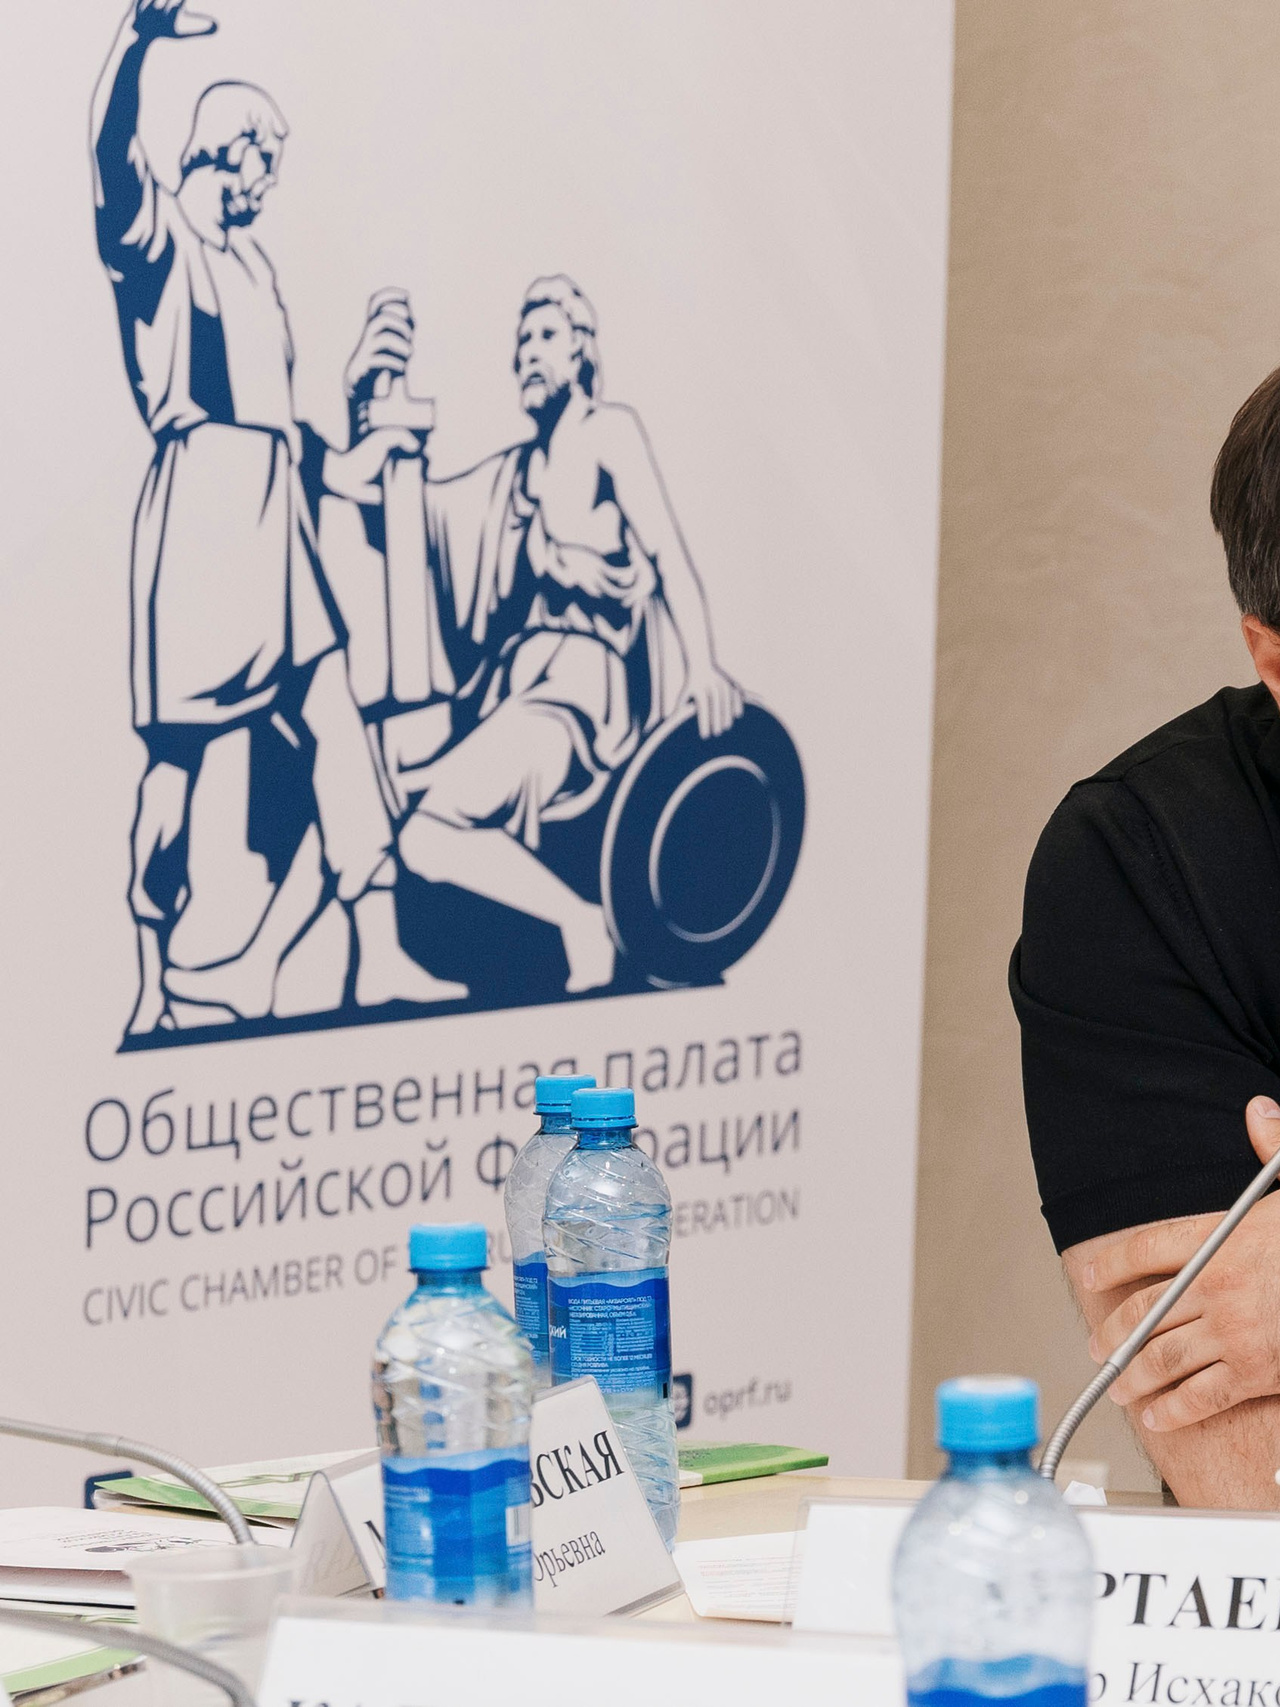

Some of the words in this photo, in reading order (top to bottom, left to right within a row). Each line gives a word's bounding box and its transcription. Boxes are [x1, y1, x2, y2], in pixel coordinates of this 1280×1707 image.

[605, 1029, 802, 1093] палата
[86, 1136, 453, 1249] Российской
[83, 1278, 170, 1326] CIVIC
[180, 1252, 344, 1312] CHAMBER
[353, 1245, 398, 1286] OF
[674, 1186, 800, 1239] ERATION
[530, 1430, 625, 1508] СКАЯ
